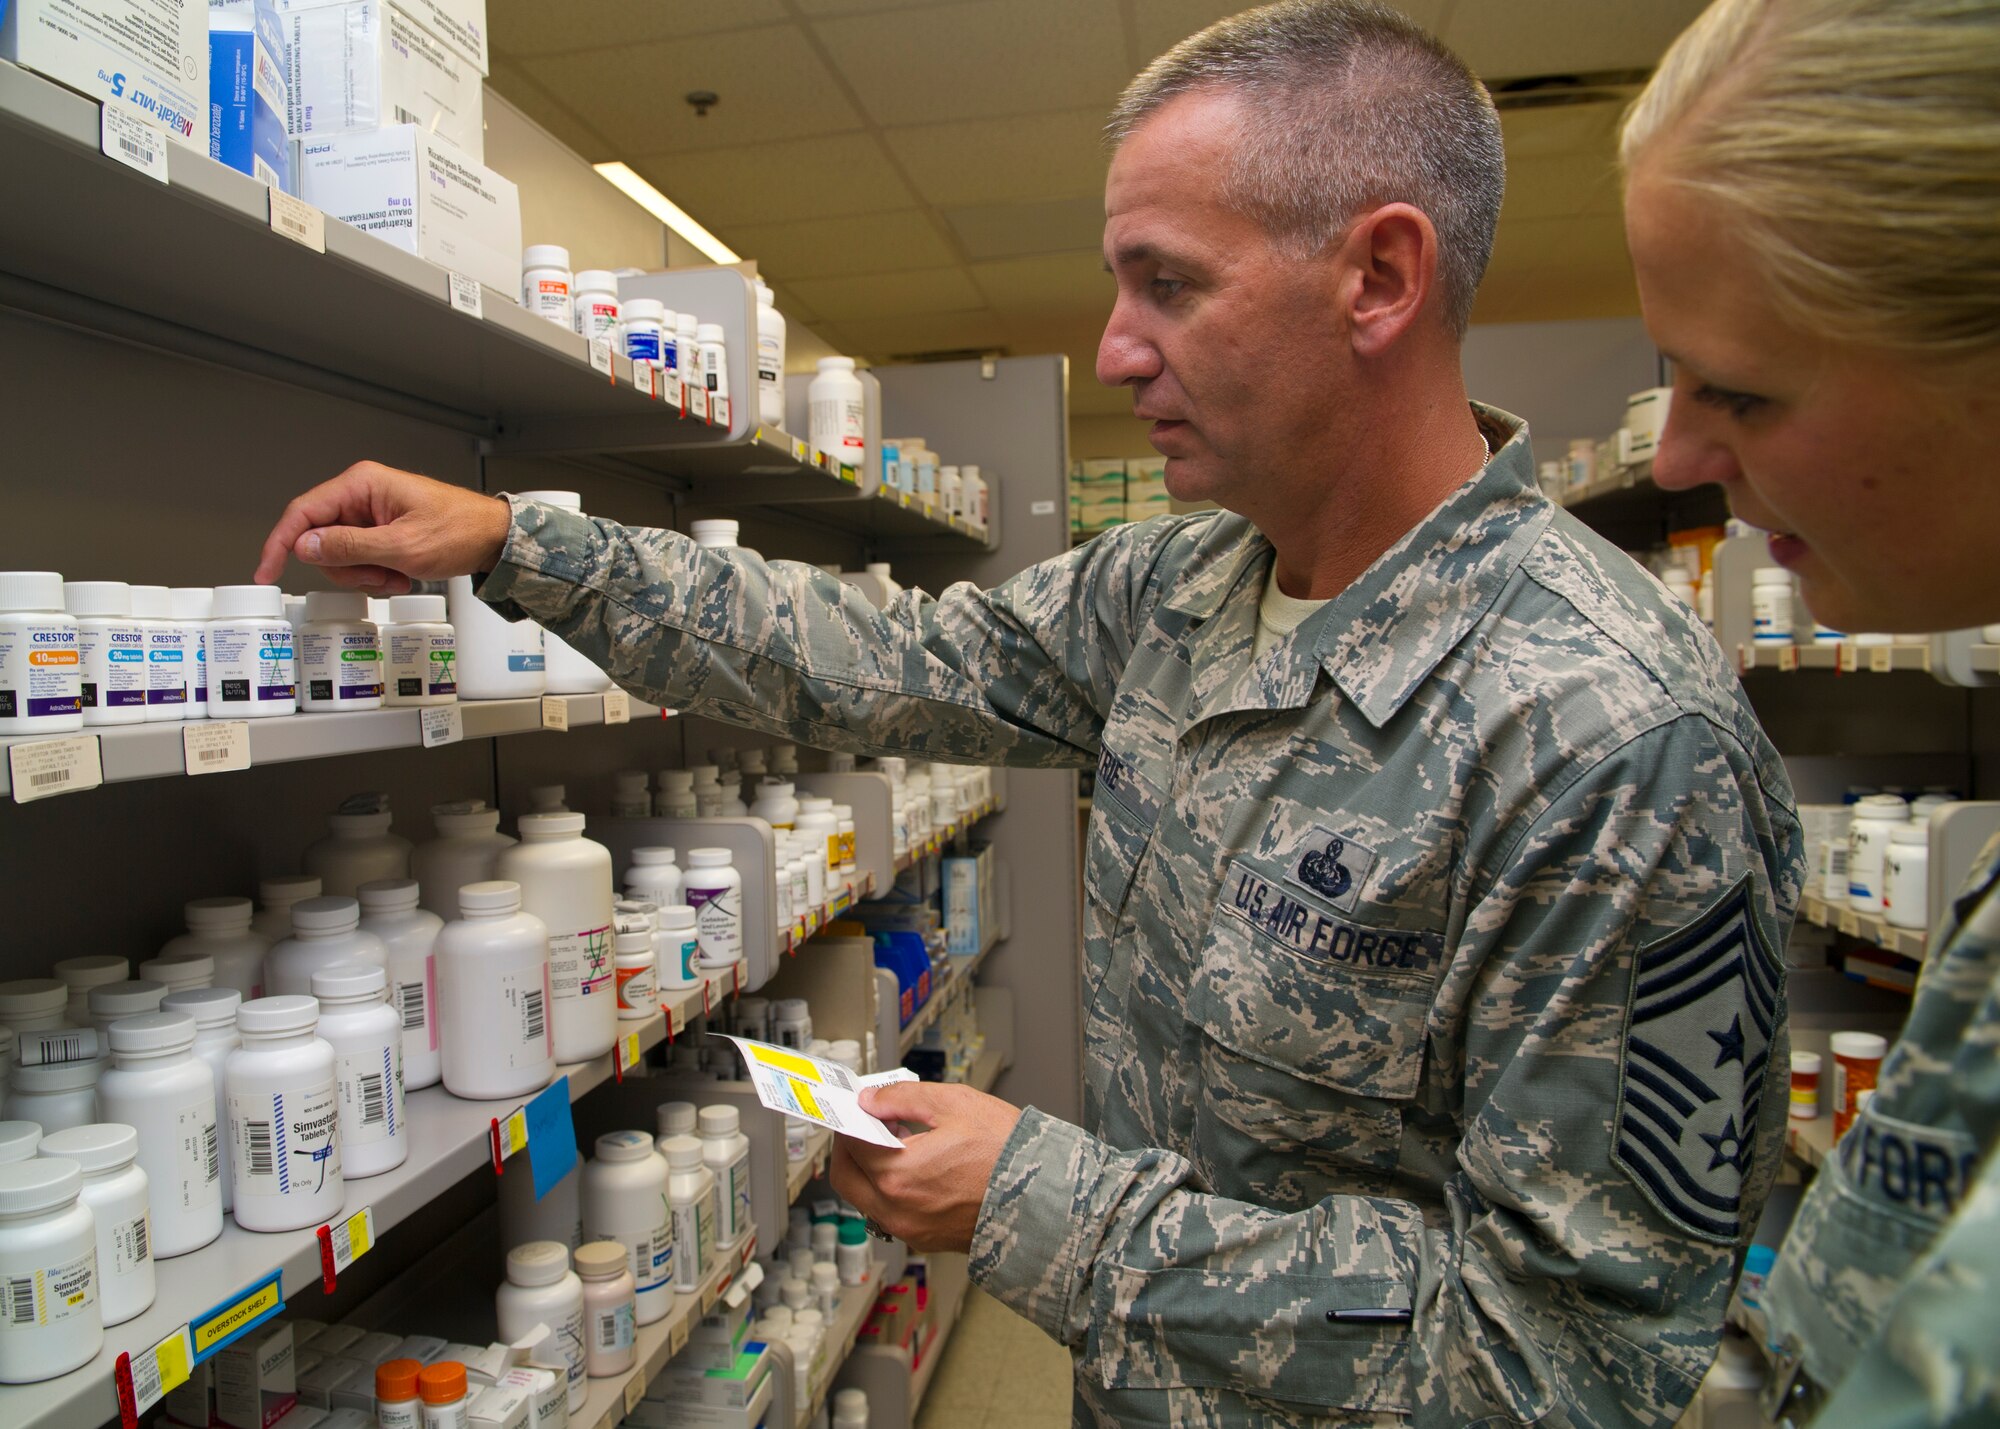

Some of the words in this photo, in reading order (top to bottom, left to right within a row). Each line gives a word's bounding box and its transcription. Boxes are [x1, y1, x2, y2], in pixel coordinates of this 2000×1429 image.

[97, 69, 112, 84] mg
[111, 72, 126, 98] 5
[304, 105, 312, 119] mg
[304, 121, 311, 131] 10
[305, 144, 330, 154] PAR
[428, 146, 456, 171] Rizatriptan
[429, 170, 436, 181] 10
[436, 176, 445, 188] mg
[387, 197, 400, 205] mg
[402, 197, 411, 206] 10
[388, 208, 412, 216] ORALLY
[368, 218, 412, 229] Rizatriptan
[33, 632, 75, 642] CRESTOR
[112, 634, 142, 642] CRESTOR
[152, 635, 181, 643] CRESTOR
[262, 633, 291, 641] CRESTOR
[1268, 896, 1308, 944] AIR
[1308, 916, 1422, 969] FORCE
[293, 1110, 338, 1134] Simvastatin
[300, 1128, 328, 1142] Tablets,
[54, 1270, 92, 1292] Simvastatin
[59, 1287, 80, 1298] Tablets,
[81, 1280, 90, 1288] USP
[76, 1293, 84, 1302] mg
[207, 1310, 247, 1338] OVERSTOCK
[247, 1296, 267, 1313] SHELF
[266, 1412, 272, 1425] 5
